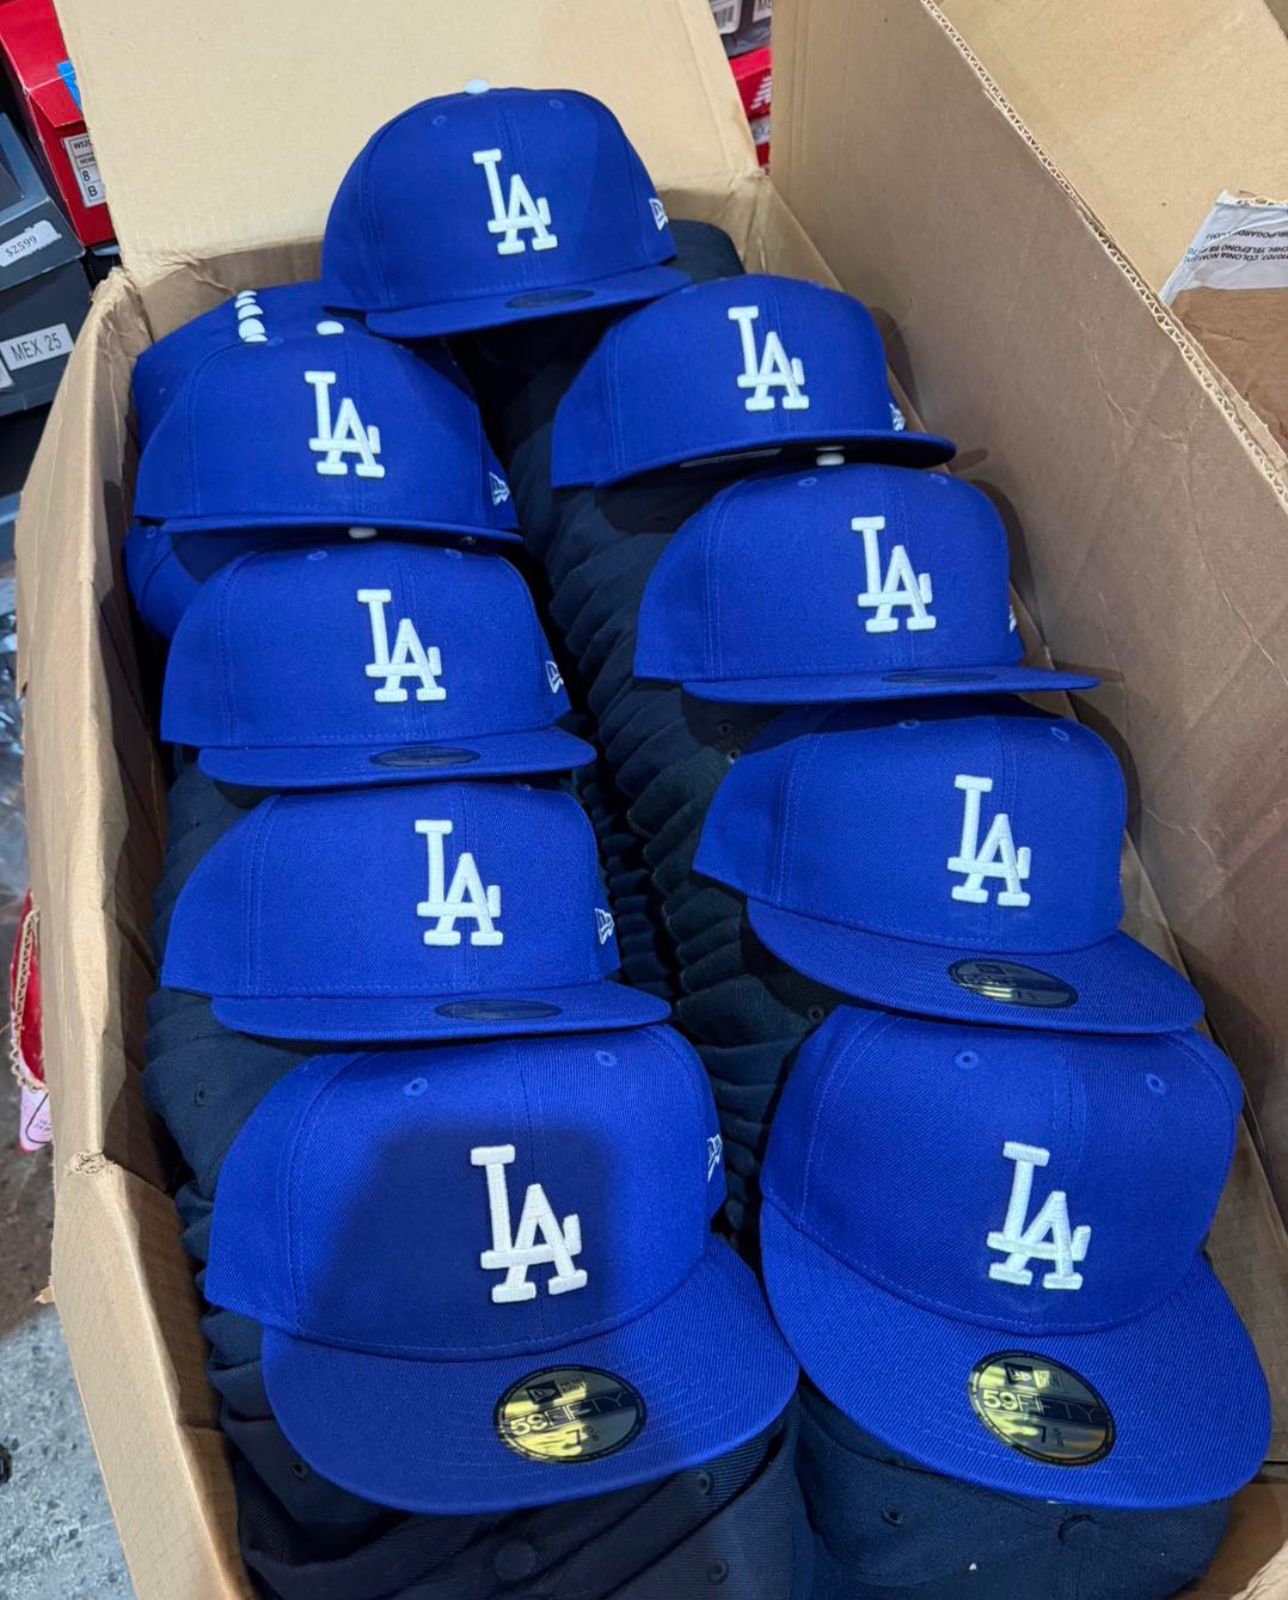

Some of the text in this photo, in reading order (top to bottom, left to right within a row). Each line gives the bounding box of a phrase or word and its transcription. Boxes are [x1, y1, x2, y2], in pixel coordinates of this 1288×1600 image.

[82, 170, 90, 182] 8
[87, 185, 98, 197] B
[474, 149, 558, 255] LA
[4, 235, 38, 258] $2599
[11, 332, 63, 362] MEX 25
[729, 306, 810, 411] LA
[304, 371, 385, 478] LA
[851, 516, 936, 633] LA
[357, 589, 447, 702] LA
[414, 819, 504, 946] LA
[947, 774, 1031, 906] LA
[470, 1144, 588, 1303] LA
[986, 1141, 1091, 1290] LA
